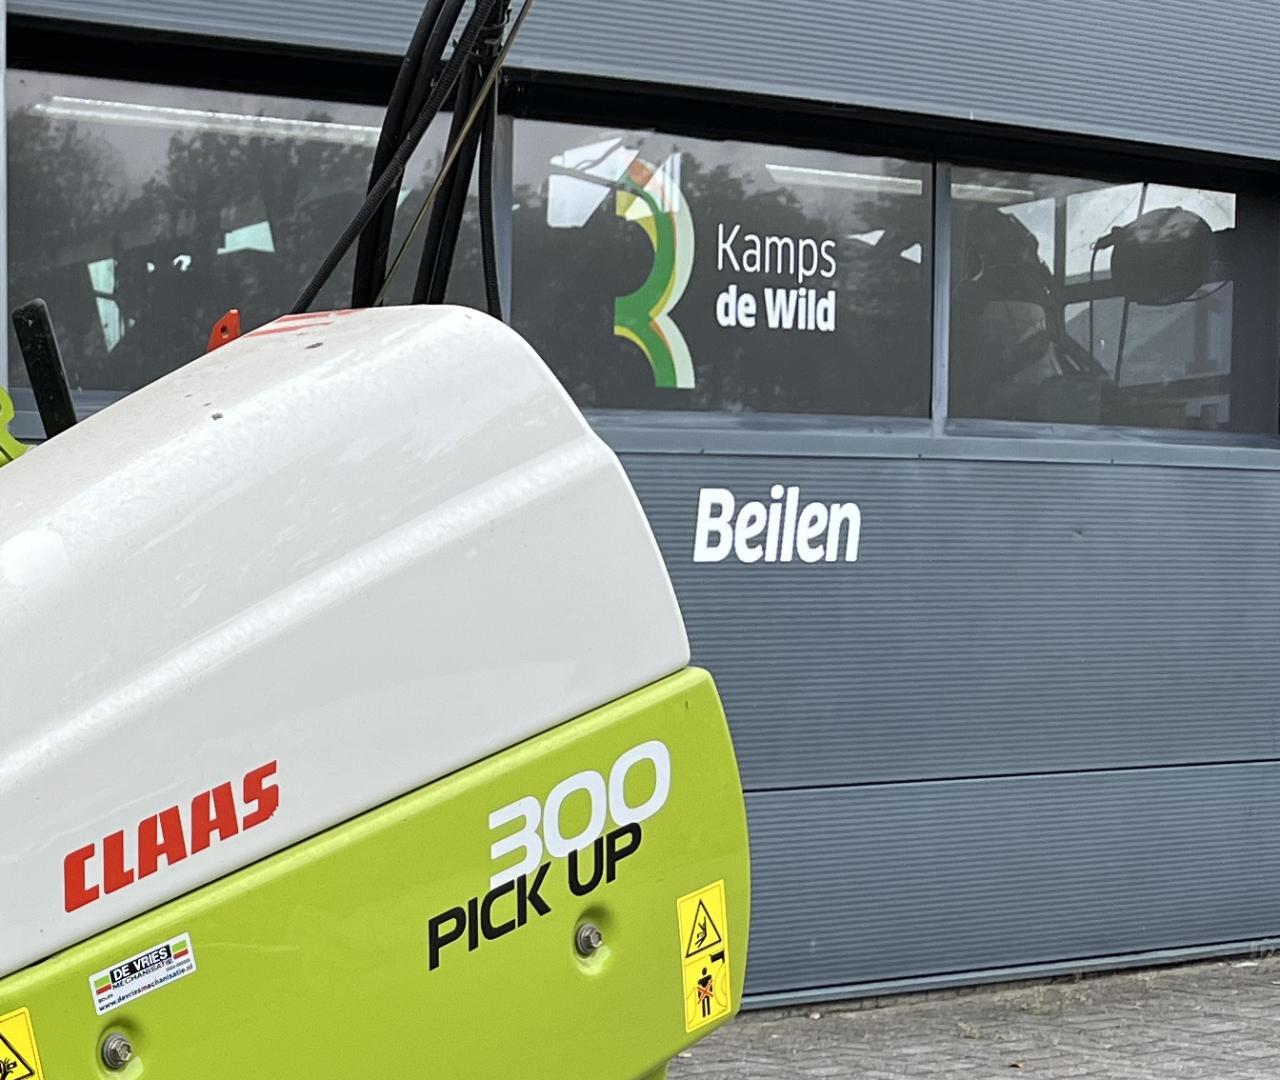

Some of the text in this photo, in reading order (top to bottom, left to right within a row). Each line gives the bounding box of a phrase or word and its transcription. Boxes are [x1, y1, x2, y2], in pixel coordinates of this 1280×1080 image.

[716, 223, 837, 284] Kamps
[716, 285, 837, 332] de Wild
[693, 484, 862, 565] Beilen
[63, 759, 280, 913] CLAAS
[487, 739, 672, 890] 300
[427, 822, 642, 971] PICK UP
[113, 965, 131, 981] DE
[133, 947, 168, 969] VRIES
